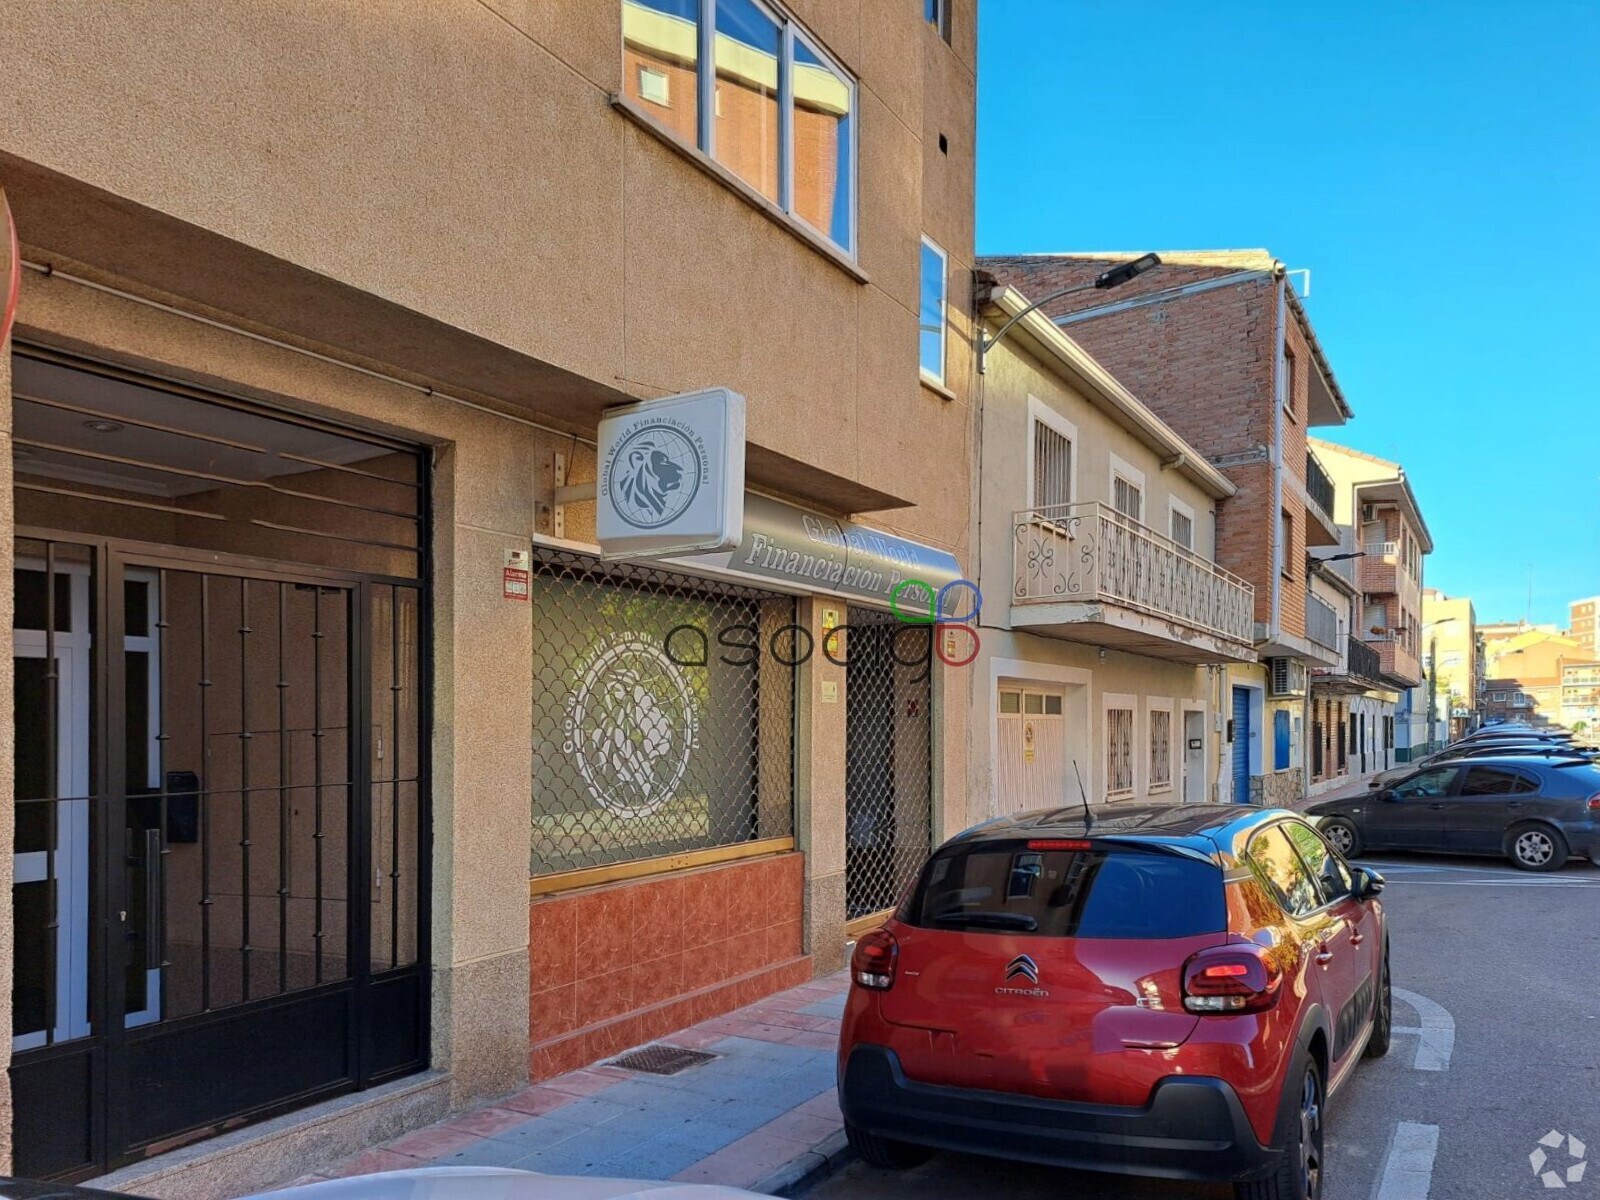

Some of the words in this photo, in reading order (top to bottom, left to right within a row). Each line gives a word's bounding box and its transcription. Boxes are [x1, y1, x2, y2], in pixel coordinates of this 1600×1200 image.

[601, 460, 612, 497] Global
[607, 428, 632, 457] World
[633, 416, 696, 438] Financiación
[694, 436, 710, 485] Personal
[744, 532, 882, 592] Financiación
